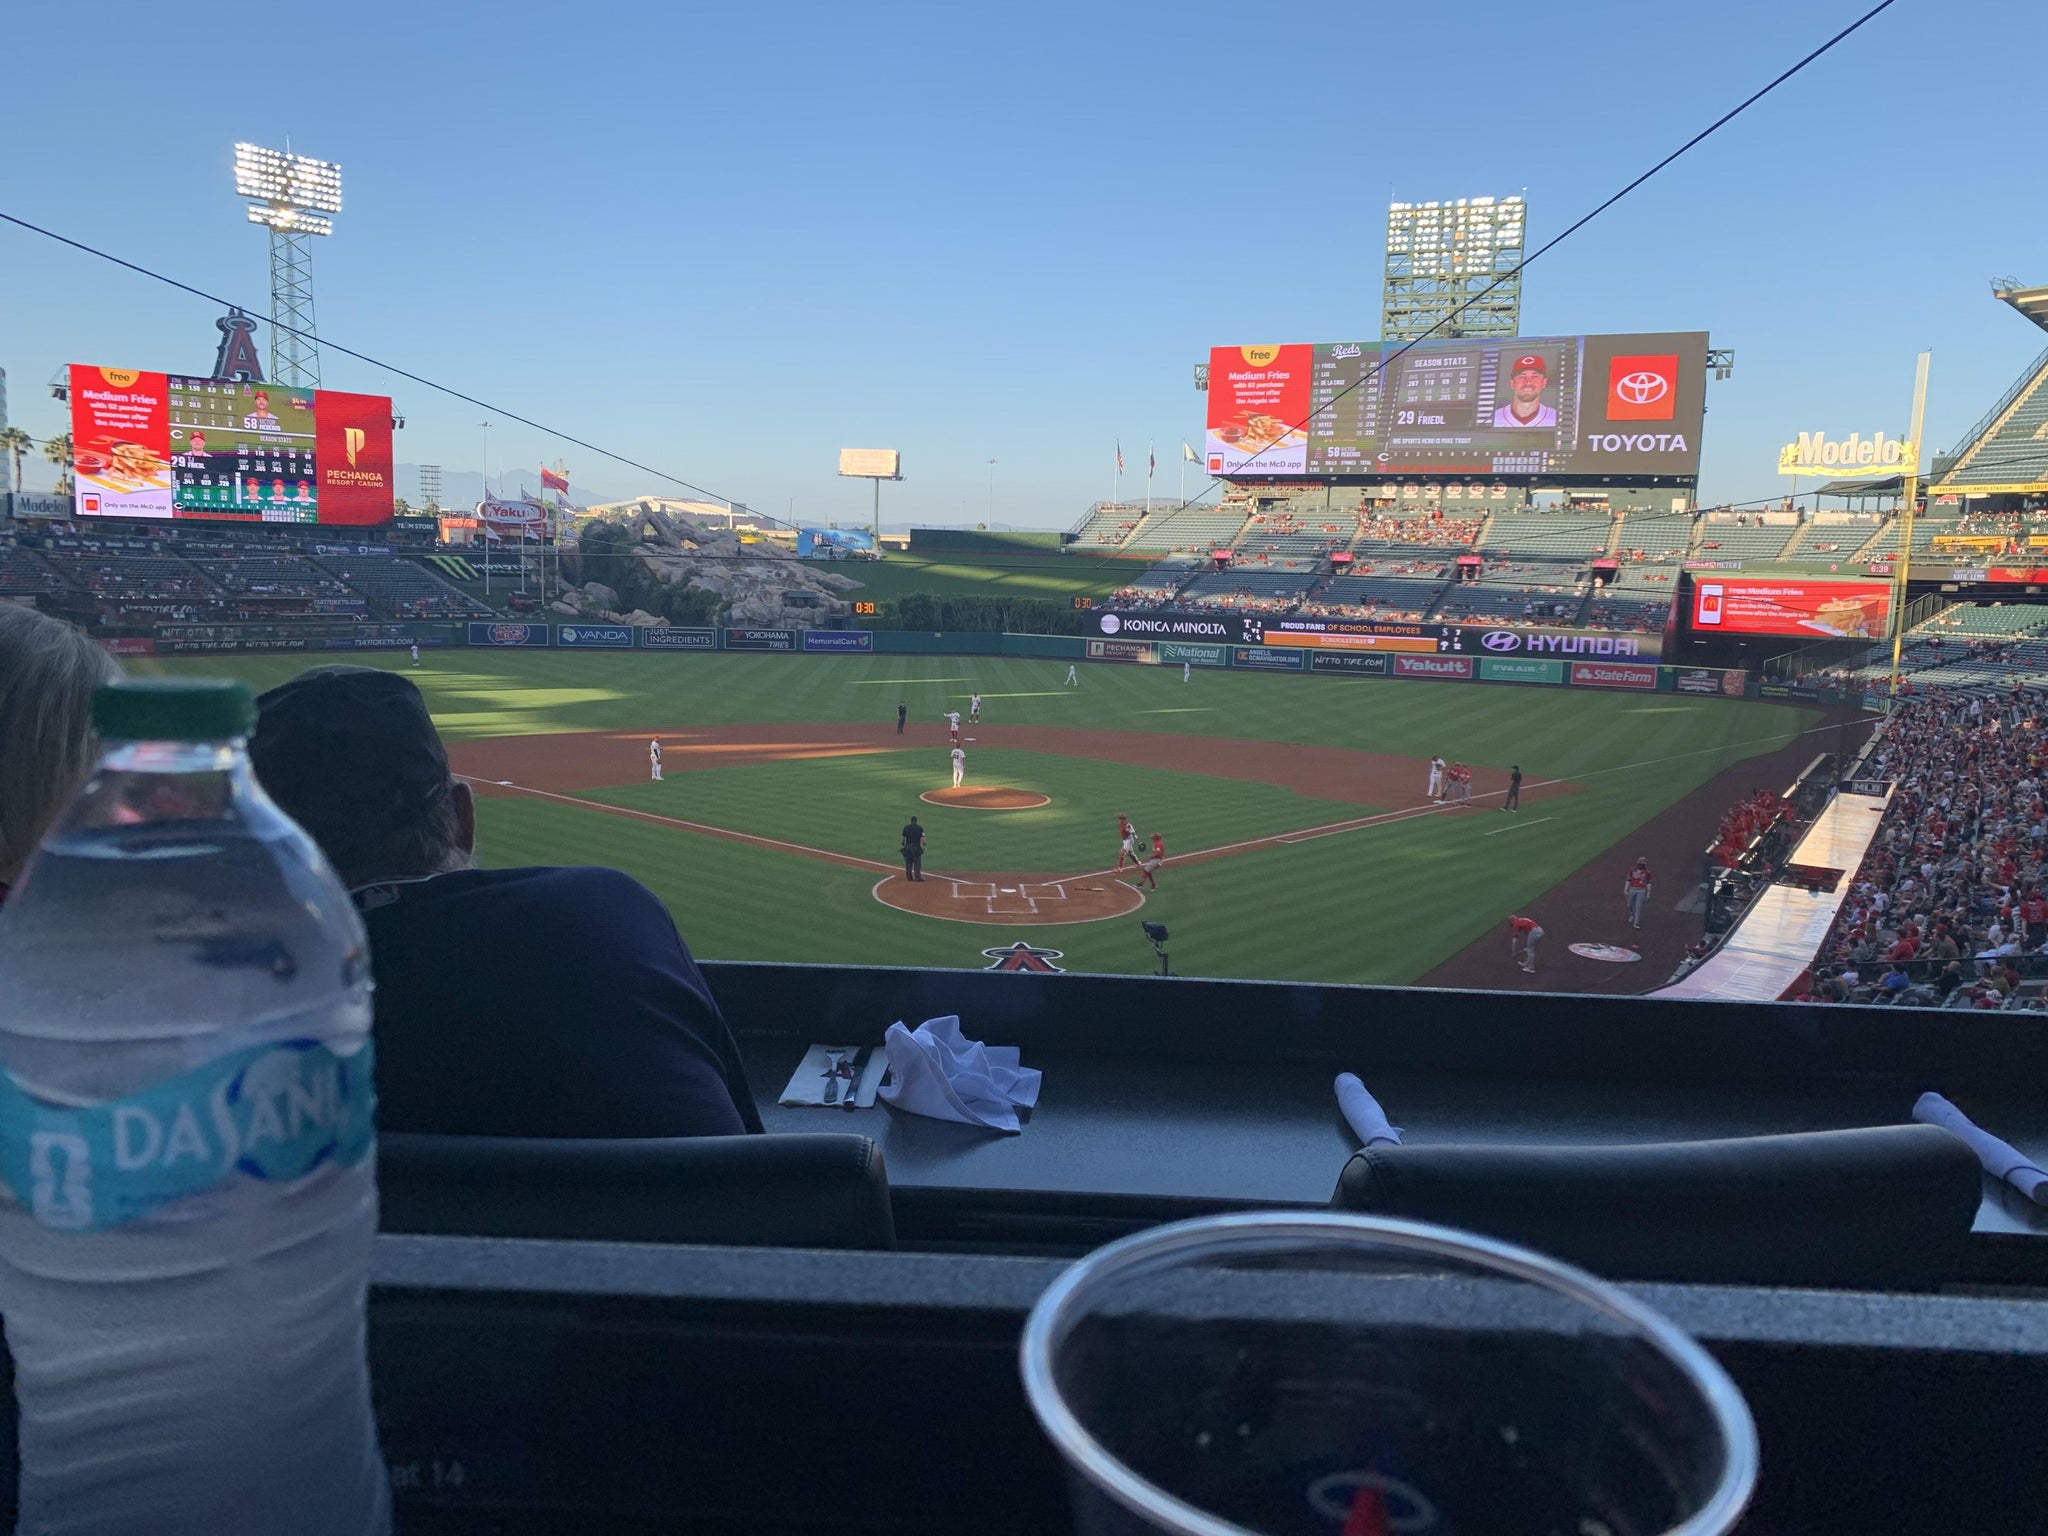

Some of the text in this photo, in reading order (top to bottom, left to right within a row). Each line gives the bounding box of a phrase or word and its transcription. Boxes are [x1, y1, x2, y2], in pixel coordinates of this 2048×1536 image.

[1250, 350, 1270, 360] free
[1332, 344, 1361, 359] Reds
[1414, 358, 1467, 368] SEASON STATS
[110, 372, 130, 381] free
[1228, 371, 1290, 381] Medium Fries
[83, 390, 158, 405] Medium Fries
[1398, 410, 1415, 425] 29
[1418, 415, 1446, 425] FRIEDL
[109, 420, 134, 429] Angels
[244, 417, 258, 429] 58
[1588, 434, 1688, 452] TOYOTA
[1328, 447, 1340, 457] 58
[1796, 431, 1901, 466] Modelo
[171, 456, 186, 467] 29
[1227, 461, 1243, 469] Only
[1256, 460, 1268, 468] the
[327, 470, 383, 481] PECHANGA
[18, 496, 64, 512] Modelo
[492, 506, 530, 518] Yaku
[1717, 561, 1738, 569] METER
[1871, 565, 1889, 573] 6:39
[1783, 588, 1804, 596] Fries
[856, 602, 874, 614] 0:30
[1074, 598, 1092, 609] 0:30
[1124, 620, 1227, 635] KONICA MINOLTA
[1244, 619, 1252, 628] T
[1281, 622, 1305, 630] PROUD
[1306, 623, 1326, 631] FANS
[1340, 624, 1373, 632] SCHOOL
[1374, 626, 1421, 634] EMPLOYEES
[578, 630, 628, 640] VANDA
[650, 628, 668, 636] JUST
[745, 631, 790, 639] YOKOHAMA
[354, 638, 414, 646] 714TICKETS.COM
[650, 636, 710, 645] INGREDIENTS
[769, 641, 789, 649] TIRES
[1527, 634, 1639, 656] HYUNDAI
[1106, 645, 1146, 653] PECHANGA
[1177, 647, 1220, 658] National
[1315, 657, 1384, 667] NITTO TIRE.COM
[1401, 659, 1466, 673] Yakult
[1854, 784, 1880, 792] MLB
[112, 1064, 342, 1181] DASANI
